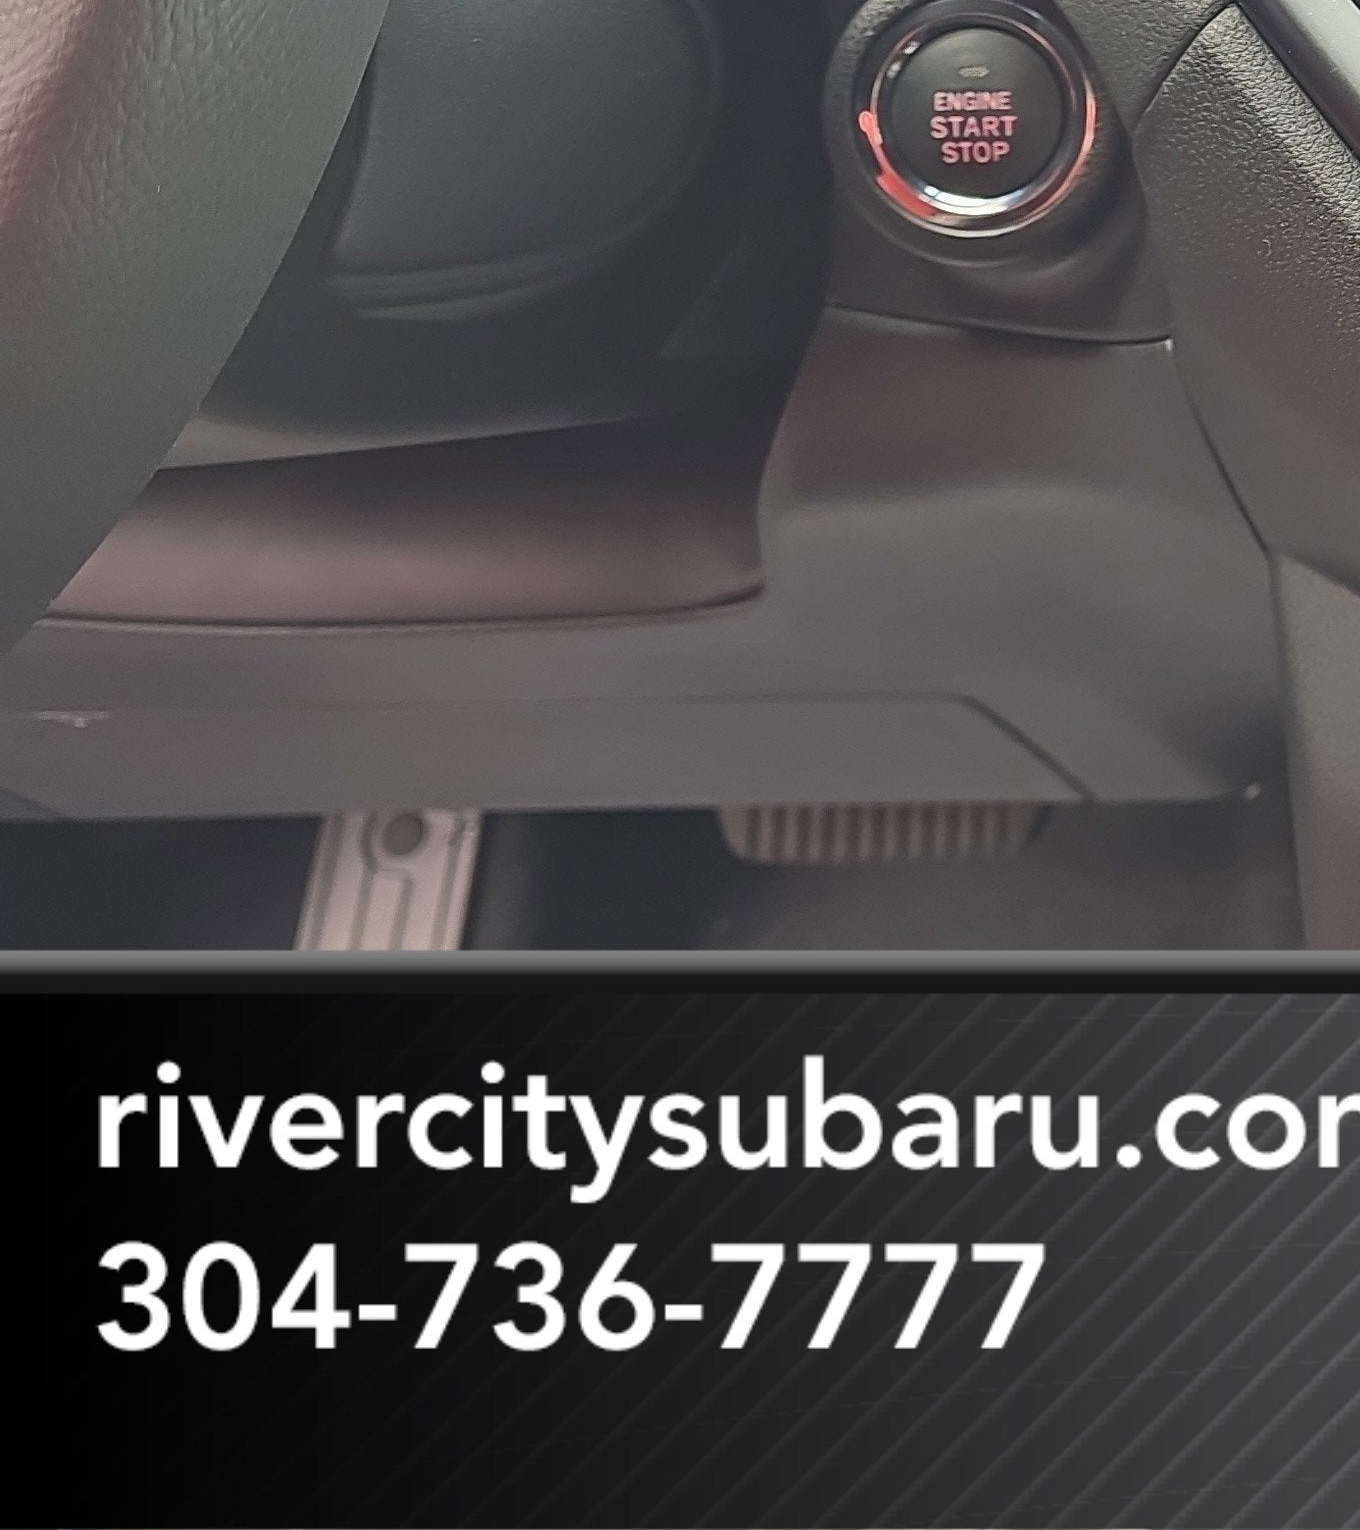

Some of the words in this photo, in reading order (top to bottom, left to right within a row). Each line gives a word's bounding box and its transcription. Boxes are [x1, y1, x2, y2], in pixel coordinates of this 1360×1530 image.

[933, 91, 1012, 111] ENGINE
[930, 115, 1017, 139] START
[941, 141, 1010, 163] STOP
